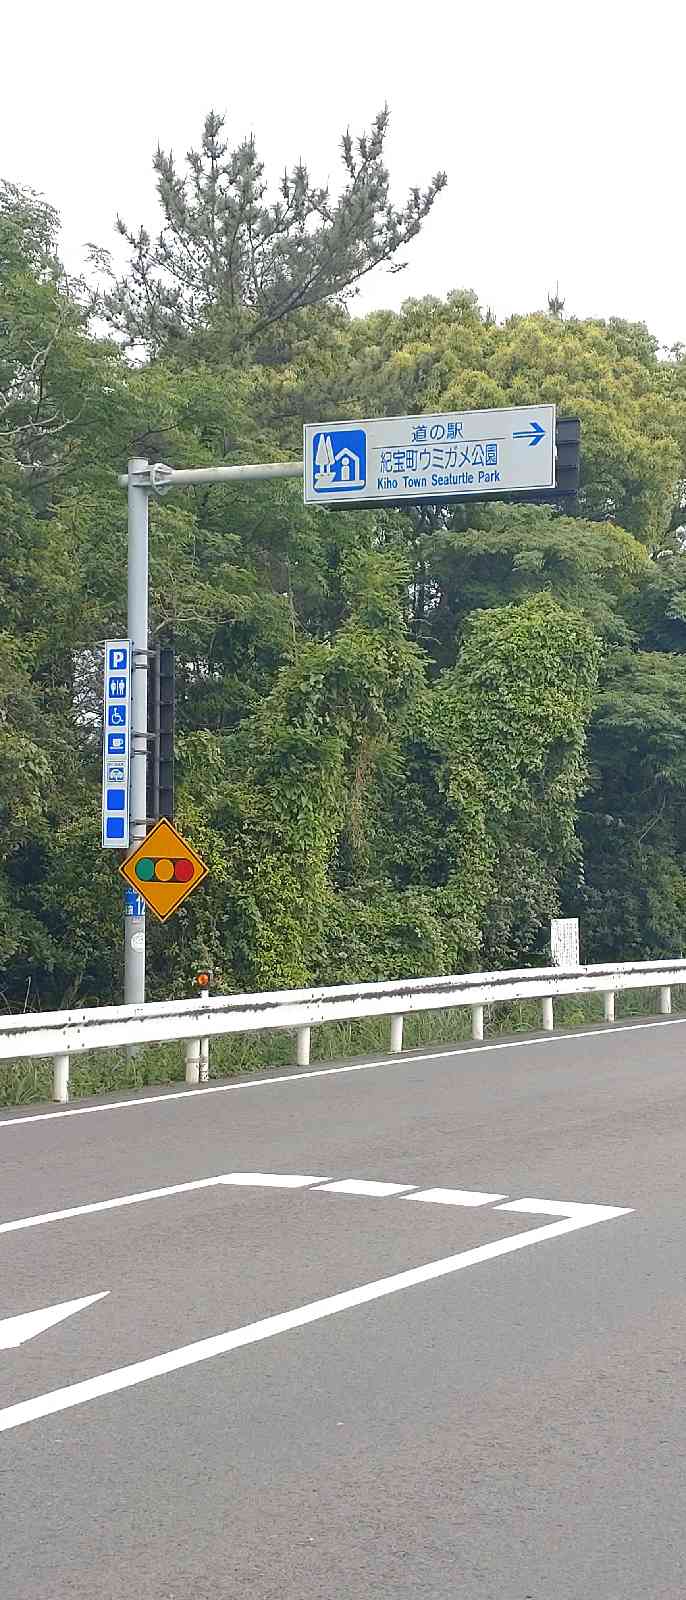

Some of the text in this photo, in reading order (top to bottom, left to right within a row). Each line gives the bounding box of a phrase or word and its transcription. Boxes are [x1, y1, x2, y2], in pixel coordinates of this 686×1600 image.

[411, 422, 464, 442] 道の駅
[380, 443, 498, 473] 紀宝町ウミガメ公園
[377, 471, 500, 490] Kiho Town Seaturtle Park
[114, 652, 124, 667] P
